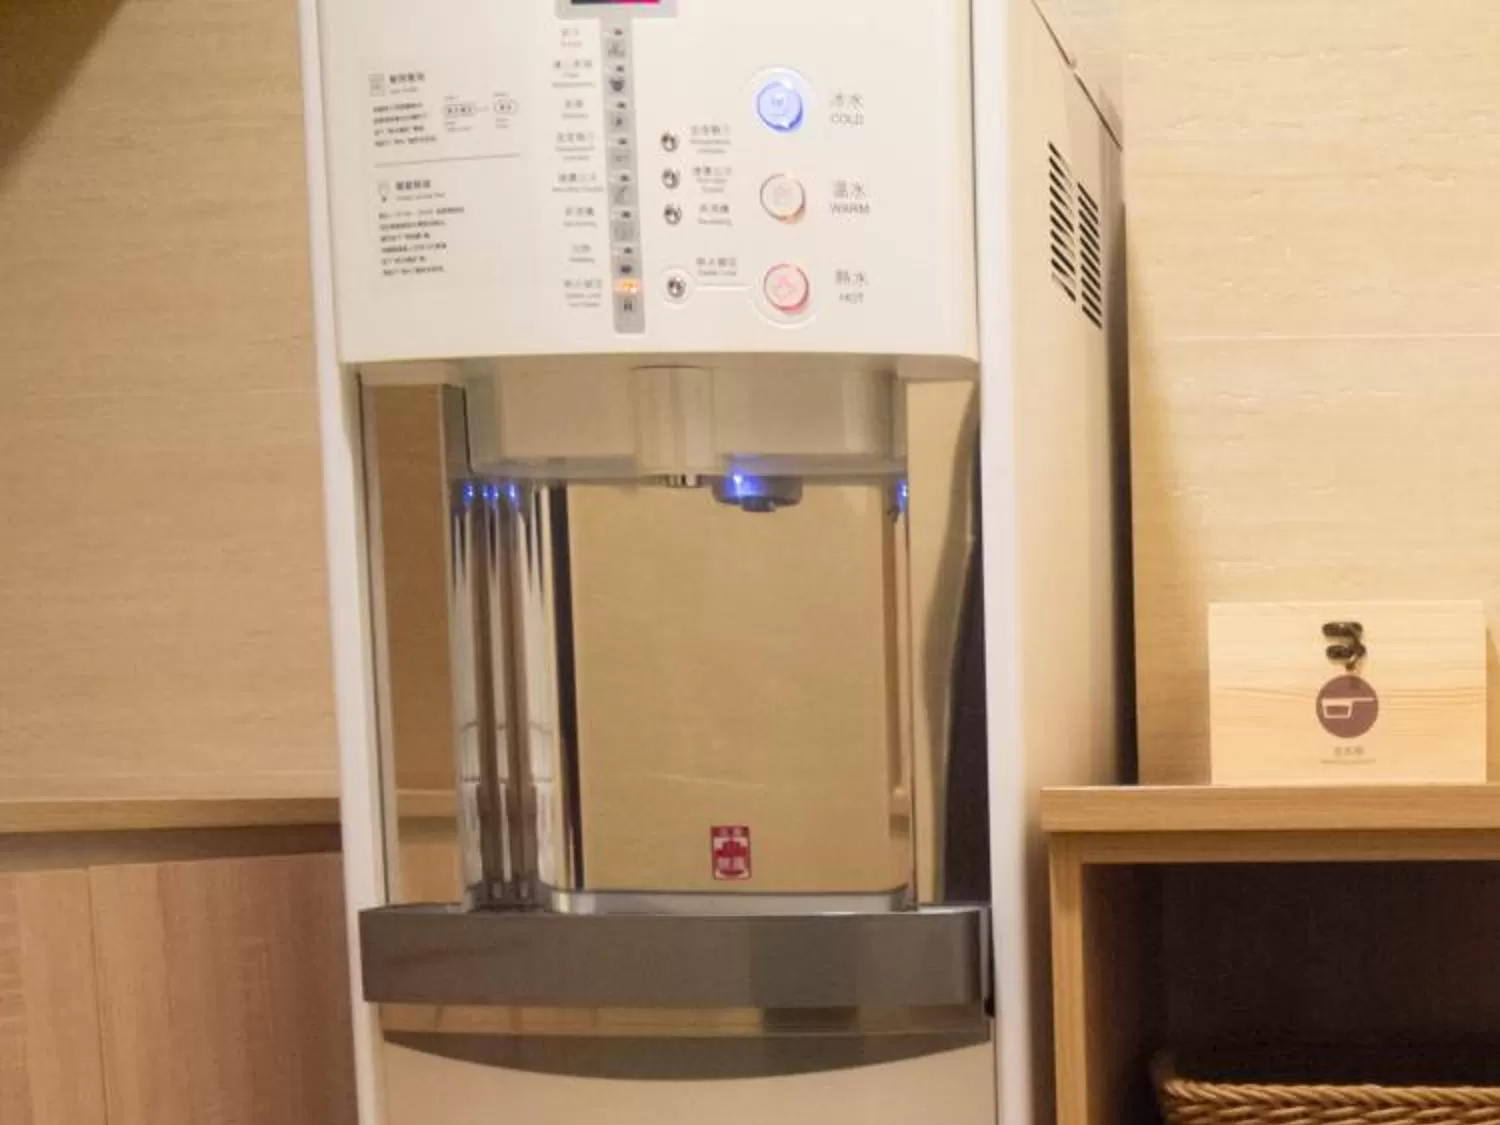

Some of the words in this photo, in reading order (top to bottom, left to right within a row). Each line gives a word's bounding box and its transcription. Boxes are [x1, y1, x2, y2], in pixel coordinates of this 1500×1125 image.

[831, 112, 864, 125] COLD
[831, 202, 870, 215] WARM
[838, 292, 864, 304] HOT
